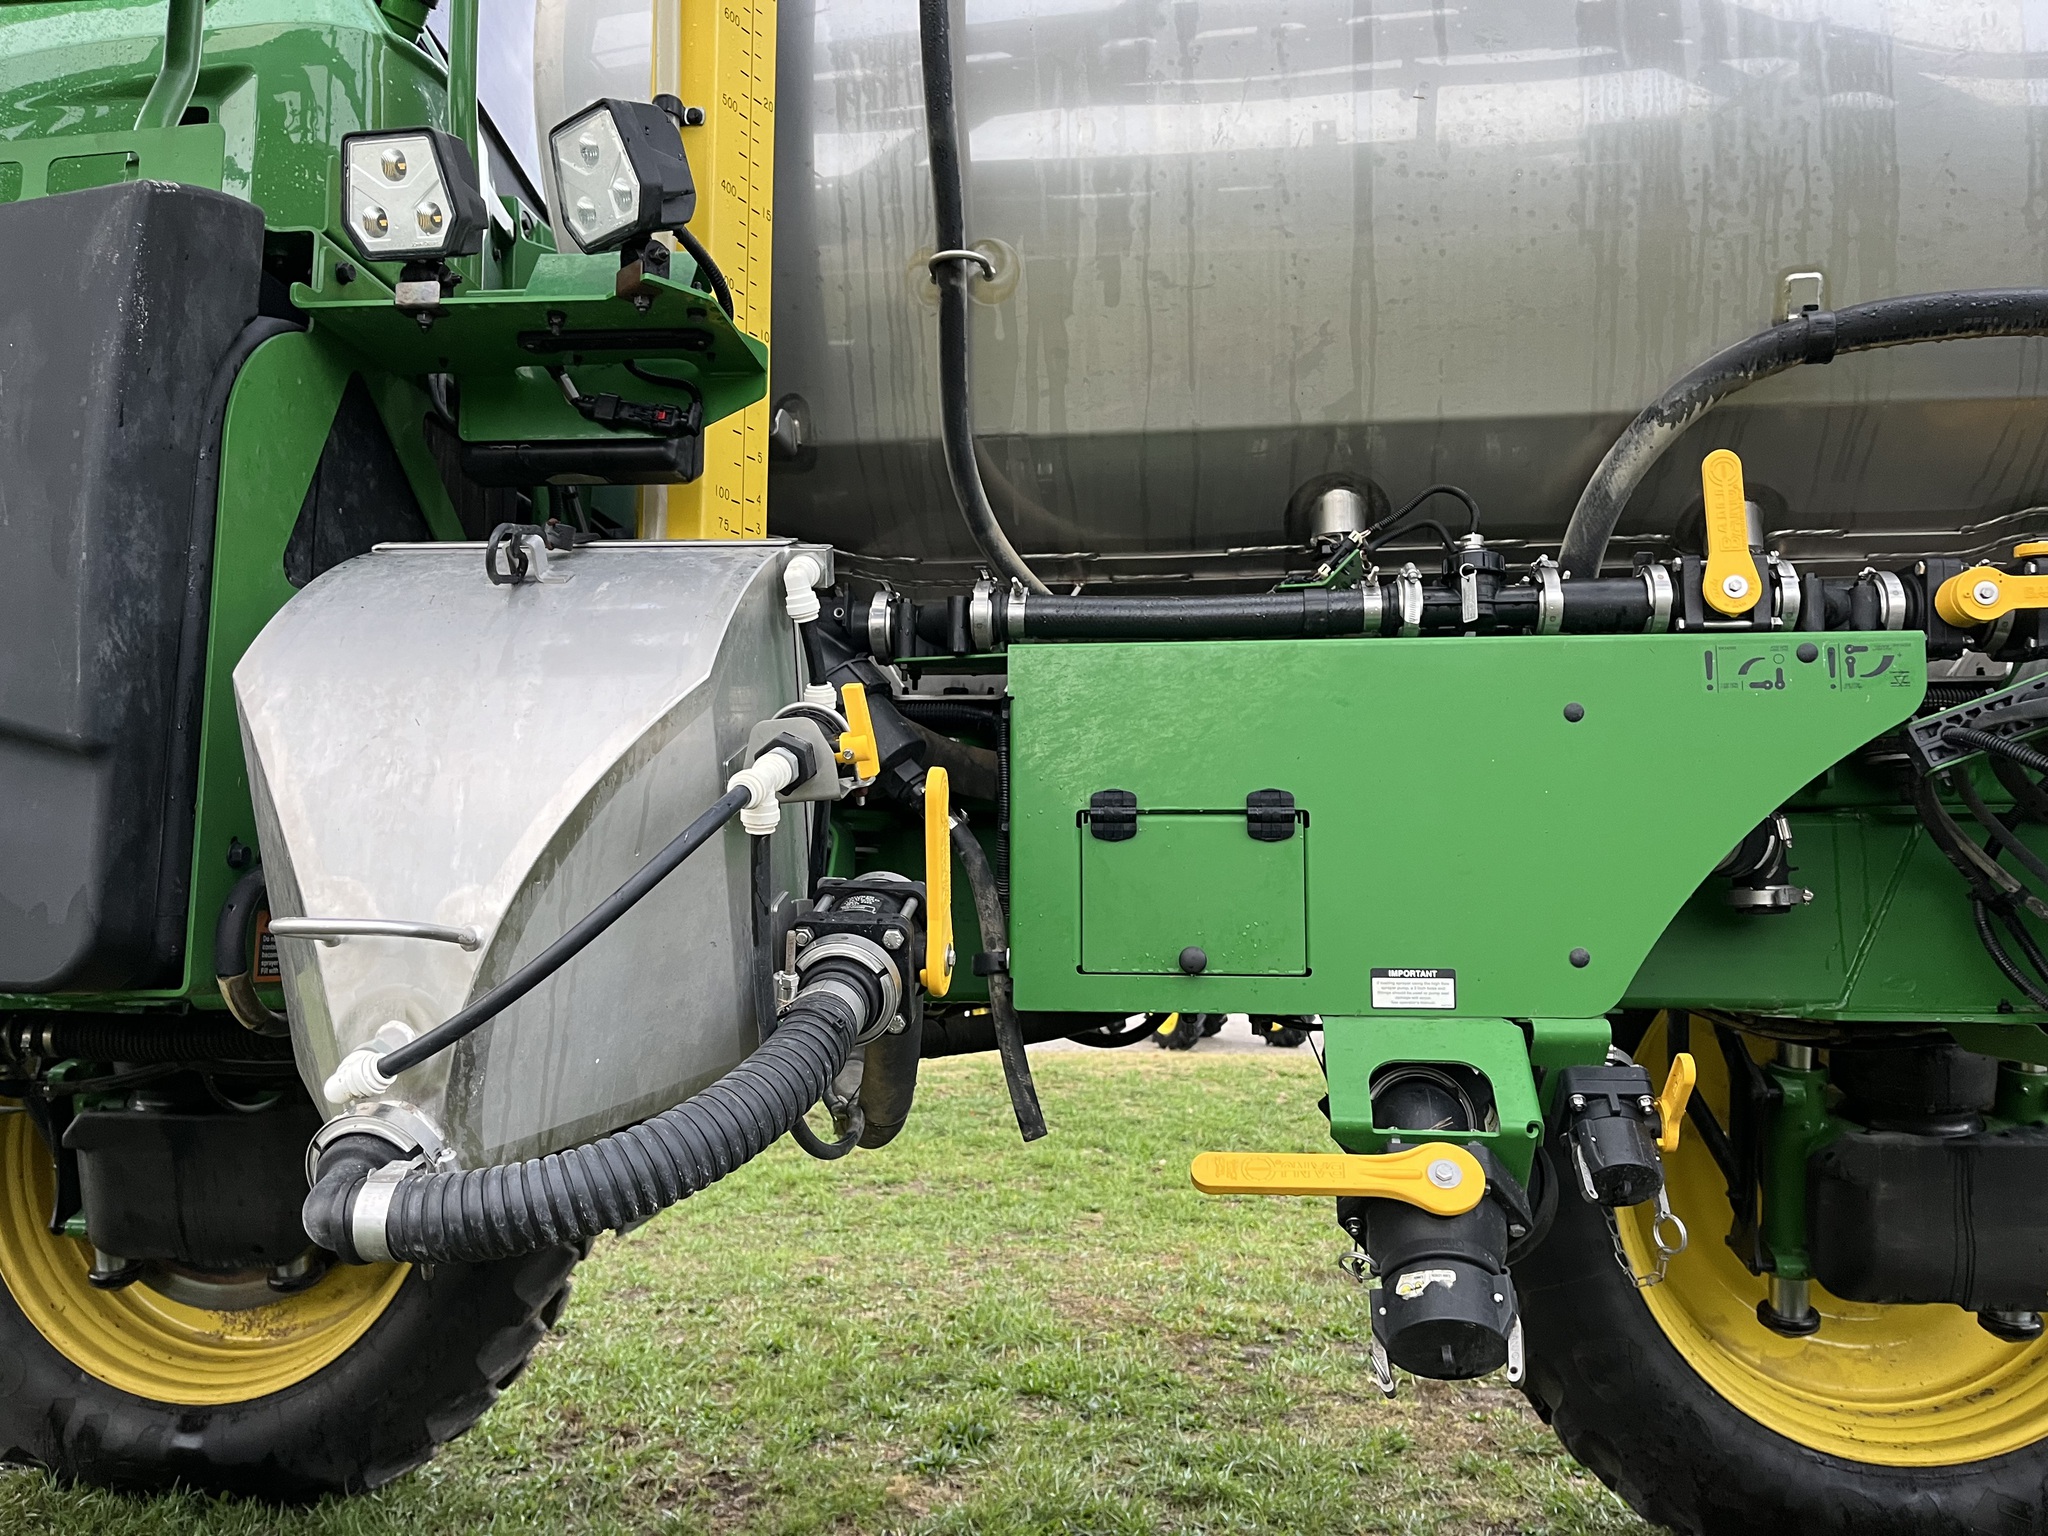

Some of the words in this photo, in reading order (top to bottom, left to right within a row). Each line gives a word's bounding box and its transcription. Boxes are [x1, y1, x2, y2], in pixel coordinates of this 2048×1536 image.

[724, 7, 740, 26] 600
[722, 93, 738, 112] 500
[763, 97, 774, 113] 20
[720, 179, 737, 197] 400
[762, 207, 772, 221] 15
[760, 329, 770, 343] 10
[757, 451, 763, 464] 5
[715, 484, 730, 500] 100
[756, 494, 762, 505] 4
[718, 516, 730, 531] 75
[755, 522, 762, 535] 3
[1388, 969, 1438, 978] IMPORTANT
